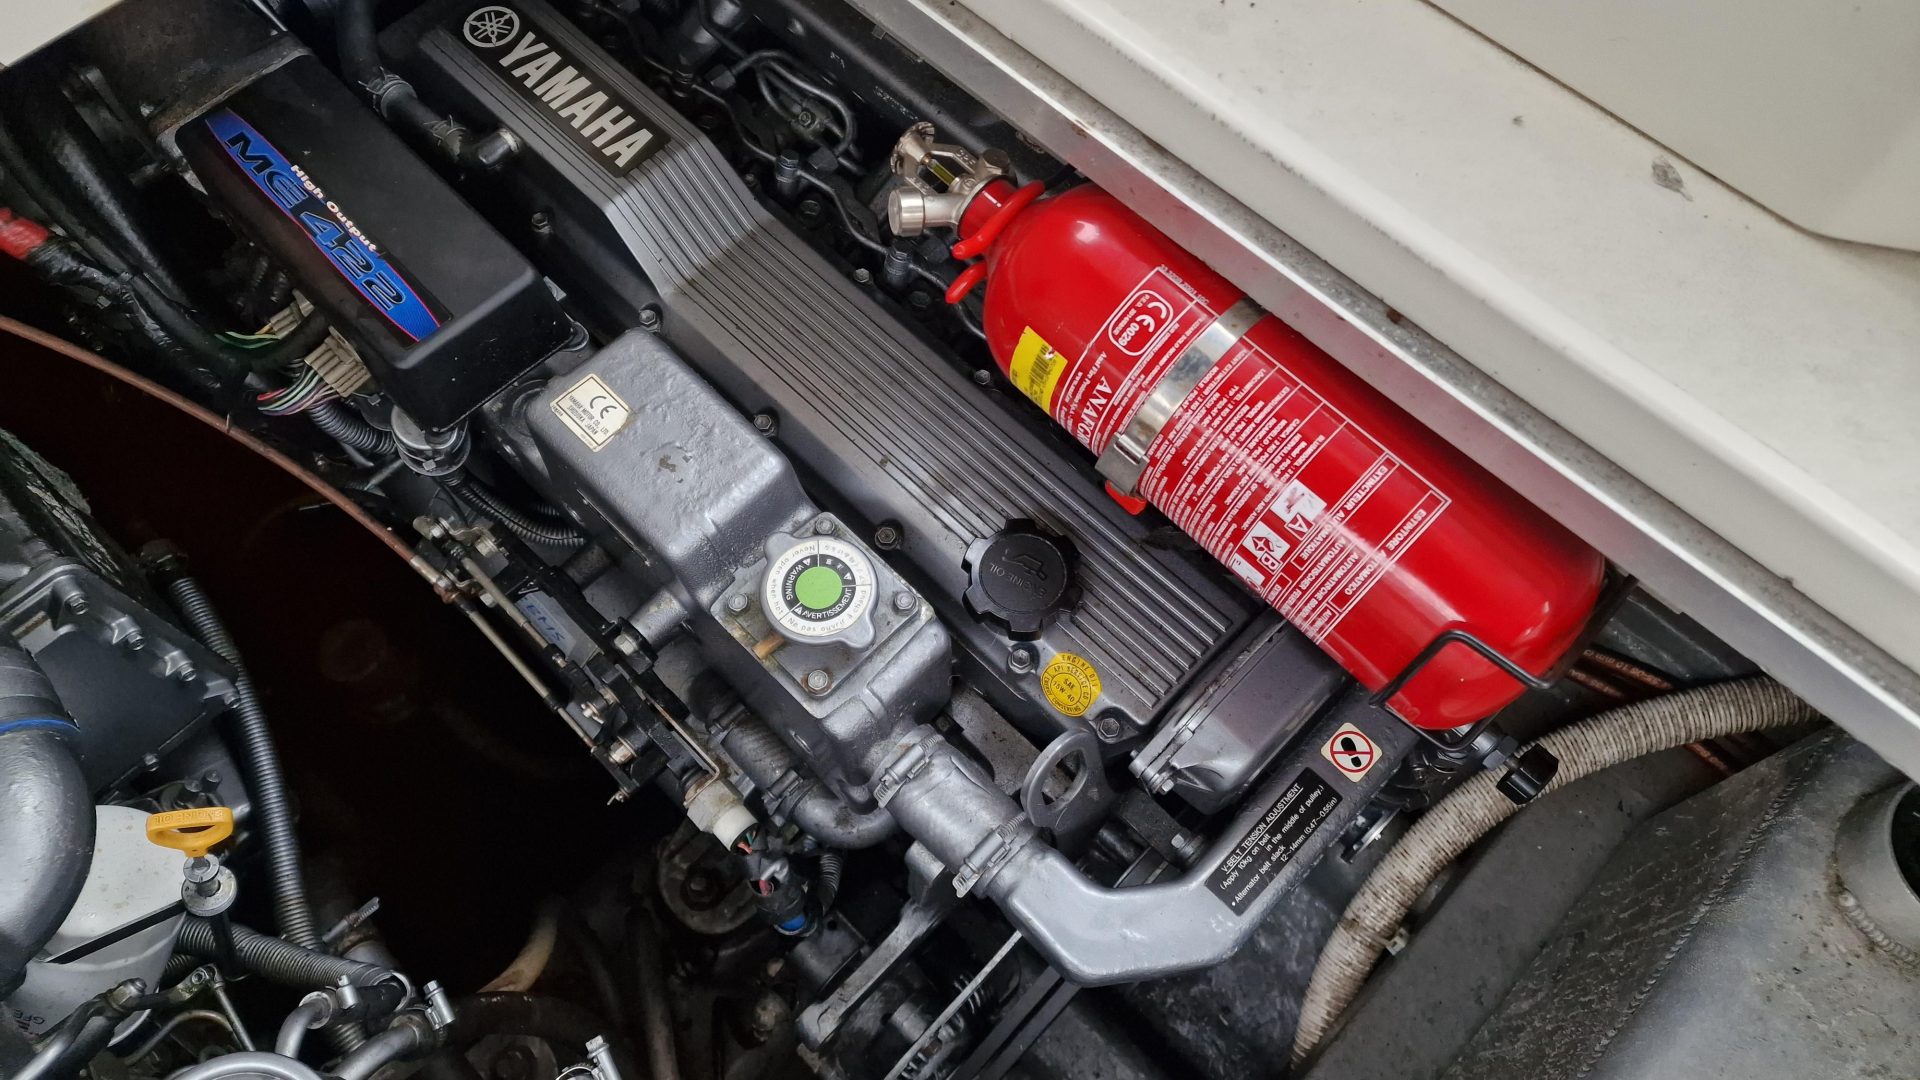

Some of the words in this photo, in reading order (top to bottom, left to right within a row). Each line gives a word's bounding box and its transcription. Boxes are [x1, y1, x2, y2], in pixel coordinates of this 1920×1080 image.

[498, 28, 653, 168] YAMAHA
[289, 163, 325, 200] High
[324, 198, 378, 253] Output
[298, 202, 408, 311] 422
[1116, 320, 1140, 347] 0029
[1094, 351, 1107, 368] Anaf
[1086, 365, 1097, 379] Fire
[1197, 365, 1219, 388] MODELE
[1202, 362, 1233, 395] EXTINCTEUR
[1204, 391, 1220, 408] NACH
[1226, 383, 1239, 397] TYP
[581, 407, 594, 421] MOTOR
[586, 391, 617, 421] CE
[1189, 400, 1200, 410] KG
[1220, 406, 1230, 416] KG
[1245, 399, 1264, 420] MODEL
[584, 422, 598, 435] JAPAN
[1200, 414, 1213, 427] ABC
[1210, 414, 1223, 428] ABC
[1222, 403, 1249, 434] RECHARGE
[1279, 417, 1300, 439] CARICA
[1195, 426, 1213, 447] PULVER
[1261, 418, 1287, 445] MODELLO
[1218, 452, 1230, 465] ABC
[1266, 443, 1277, 454] KG
[1190, 449, 1211, 476] COMPLETE
[1248, 482, 1258, 491] OF
[1343, 463, 1388, 511] EXTINCTEUR
[1287, 513, 1311, 537] A
[1298, 509, 1346, 560] AUTOMATIQUE
[1384, 507, 1426, 551] ESTINTORE
[791, 544, 816, 558] Never
[1259, 552, 1279, 571] B
[776, 558, 789, 575] open
[988, 562, 1006, 578] OIL
[1298, 537, 1346, 590] AUTOMATISCHER
[1343, 549, 1388, 596] AUTOMATICO
[785, 563, 805, 601] WARNING
[1313, 551, 1359, 600] AUTOMATISCHE
[774, 600, 784, 614] hot
[802, 587, 853, 619] AVERTISSEMENT
[788, 616, 799, 628] Ne
[801, 624, 817, 633] pas
[821, 619, 846, 632] ouvrir
[1053, 664, 1065, 673] API
[1067, 664, 1088, 689] SERVICE
[1061, 654, 1091, 671] ENGINE
[1088, 673, 1100, 688] OIL
[1063, 678, 1076, 690] SAE
[153, 813, 173, 826] OIL
[1220, 848, 1243, 873] V-BELT
[1241, 821, 1266, 849] TENSION
[1264, 782, 1301, 823] ADJUSTMENT
[1264, 842, 1273, 852] in
[1270, 831, 1282, 844] the
[1280, 812, 1299, 833] middle
[1297, 804, 1306, 814] of
[1304, 783, 1325, 807] pulley.)
[1219, 868, 1240, 890] (Apply
[1237, 854, 1253, 871] 10kg
[1251, 846, 1260, 855] on
[1258, 832, 1271, 846] belt
[1234, 872, 1260, 903] Alternator
[1258, 860, 1271, 874] belt
[1269, 843, 1286, 862] slack
